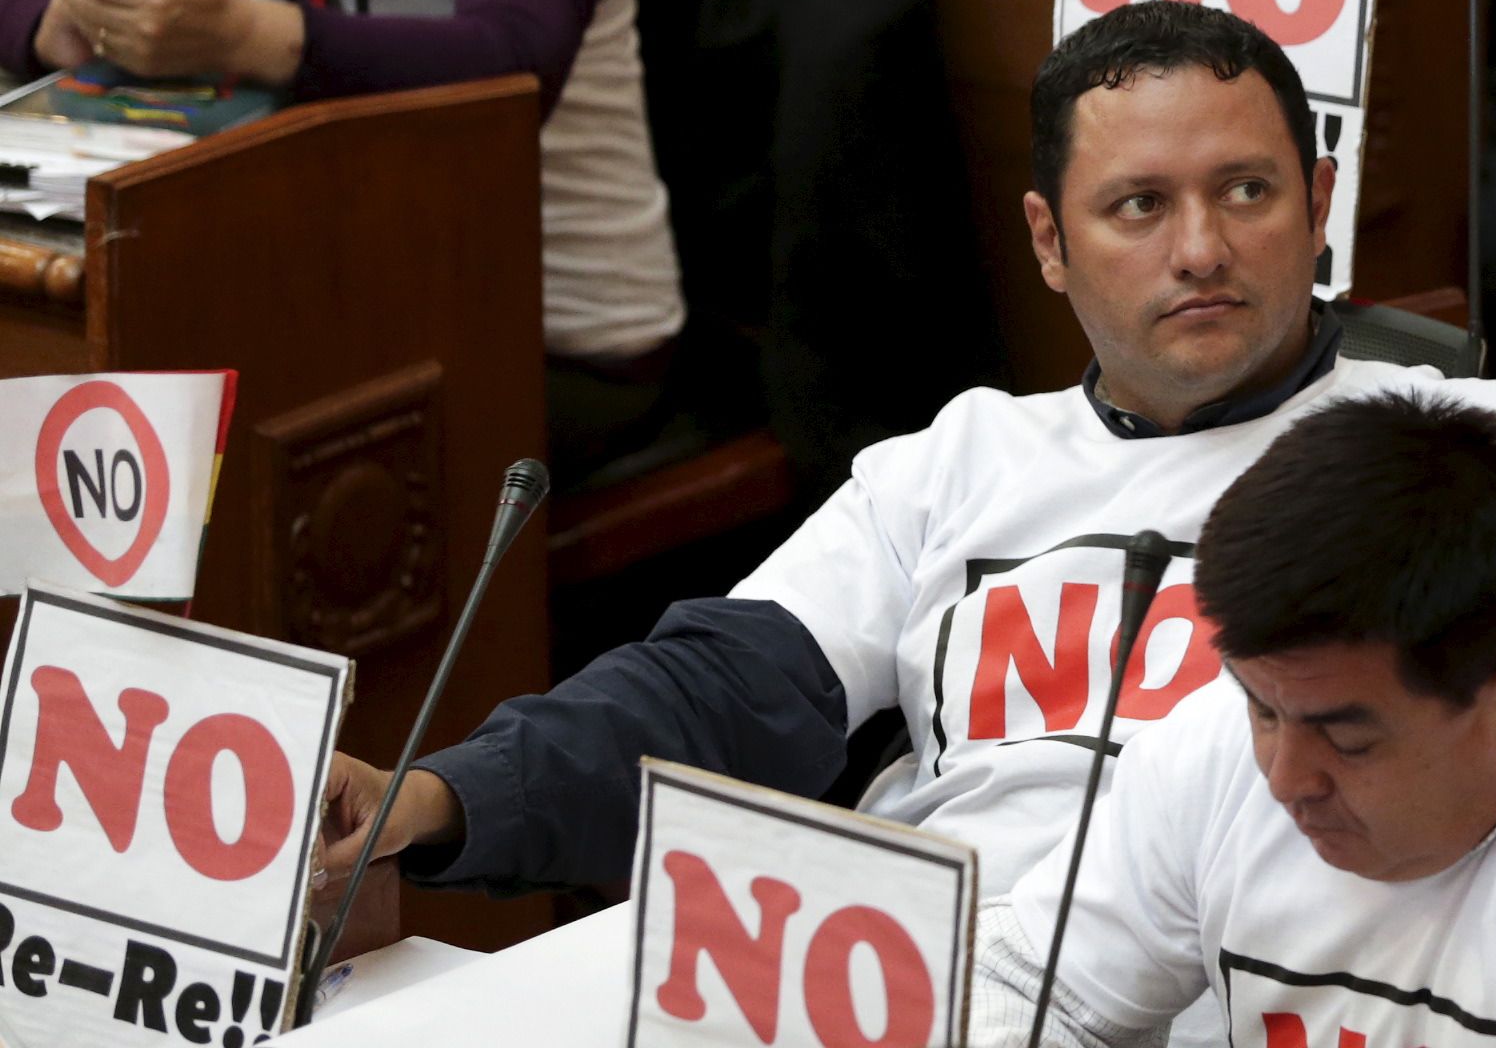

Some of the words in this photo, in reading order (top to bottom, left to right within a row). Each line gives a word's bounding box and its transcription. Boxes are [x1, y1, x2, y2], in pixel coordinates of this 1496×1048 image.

[63, 449, 143, 522] NO
[967, 582, 1223, 740] NO
[11, 665, 295, 882] NO
[0, 903, 285, 1048] e-Re!!
[657, 849, 935, 1048] NO
